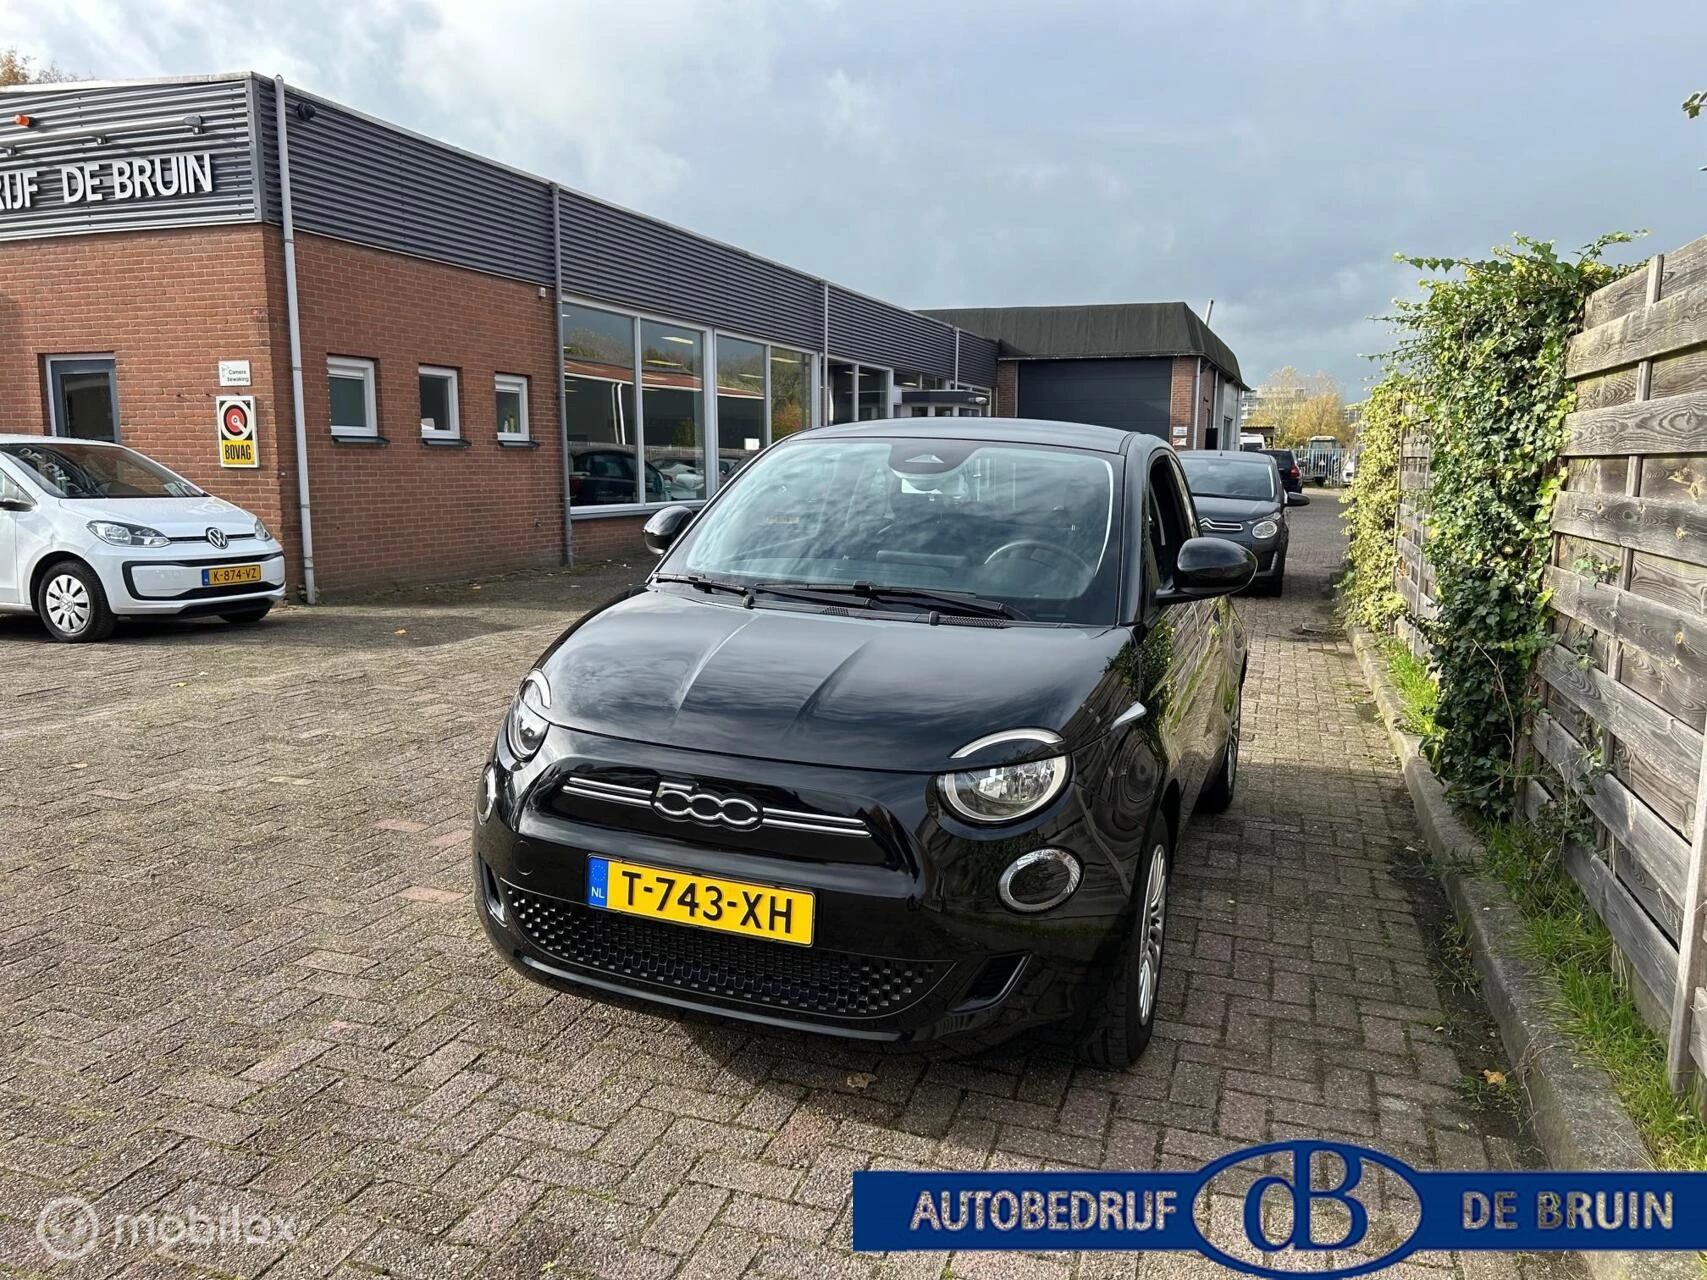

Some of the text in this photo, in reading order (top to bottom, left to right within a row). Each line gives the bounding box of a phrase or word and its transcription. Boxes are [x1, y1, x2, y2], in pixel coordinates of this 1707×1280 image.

[61, 165, 103, 203] DE
[113, 154, 213, 200] BRUIN
[224, 444, 252, 460] BOVAG
[213, 567, 257, 582] K-874-VZ
[654, 781, 759, 826] 500
[591, 886, 605, 899] NL
[621, 870, 794, 935] T-743-XH
